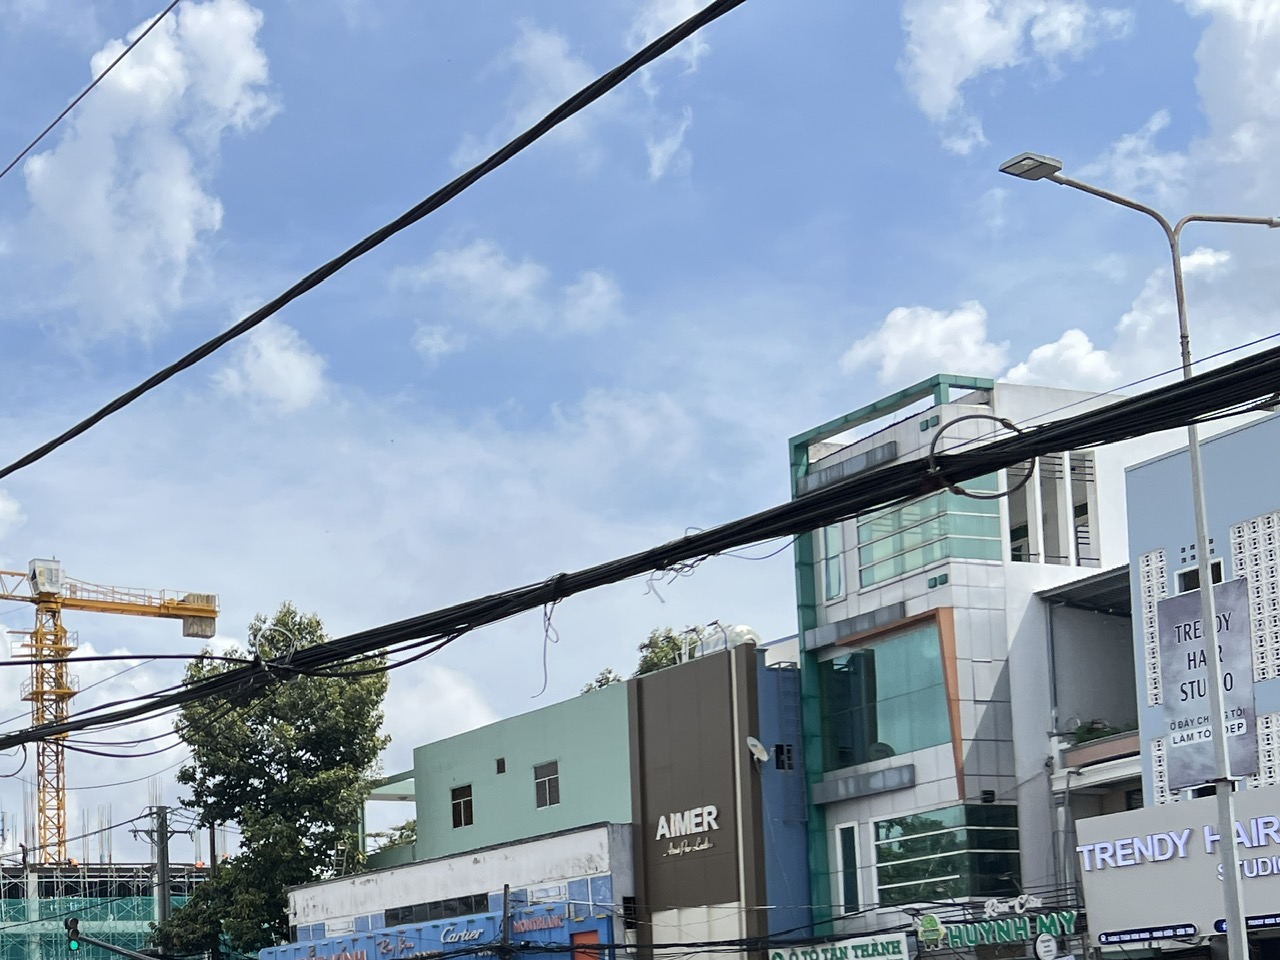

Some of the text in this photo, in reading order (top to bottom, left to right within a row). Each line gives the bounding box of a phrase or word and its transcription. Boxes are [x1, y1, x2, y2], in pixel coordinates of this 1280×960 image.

[1175, 612, 1231, 643] TREDY
[1187, 645, 1224, 670] HAR
[1180, 672, 1234, 701] STUO
[1173, 733, 1194, 745] LÀM
[655, 805, 720, 840] AIMER
[1076, 828, 1193, 871] TRENDY
[440, 926, 485, 944] Cartier
[851, 938, 903, 959] THÀNH
